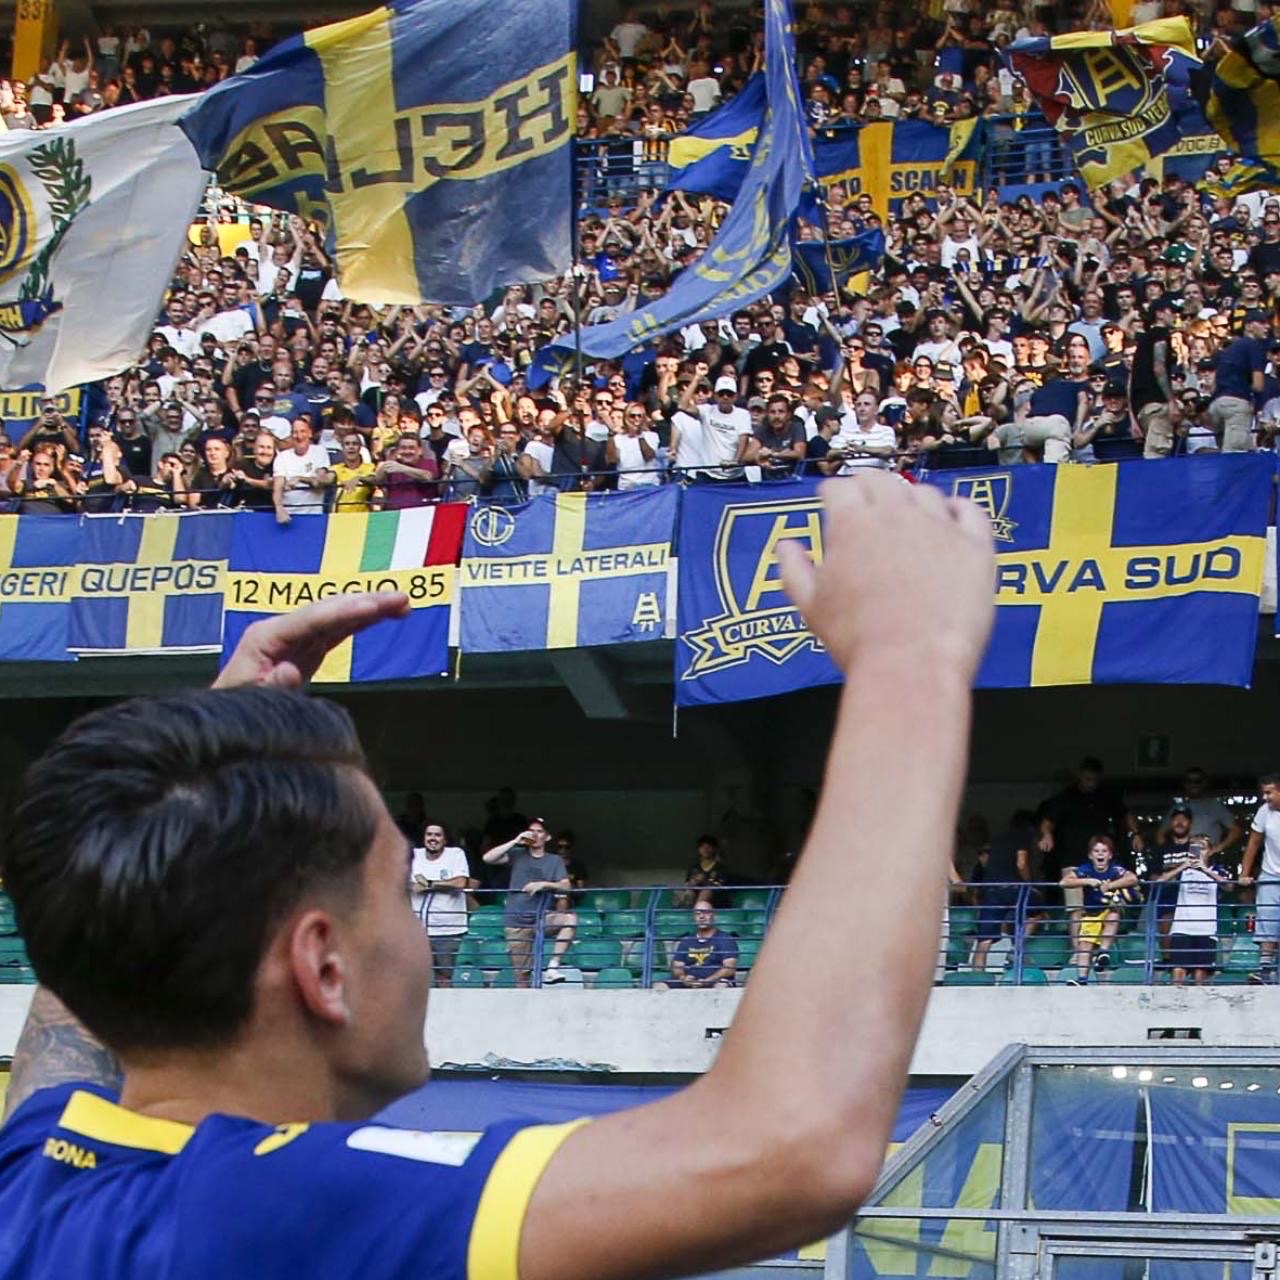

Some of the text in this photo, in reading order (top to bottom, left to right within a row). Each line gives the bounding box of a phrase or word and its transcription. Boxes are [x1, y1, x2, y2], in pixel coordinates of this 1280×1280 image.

[80, 563, 219, 592] QUEPOS
[467, 549, 666, 581] VIETTE LATERALI
[1124, 546, 1243, 590] SUD
[232, 579, 260, 604] 12
[409, 573, 446, 600] 85
[724, 614, 796, 643] CURVA
